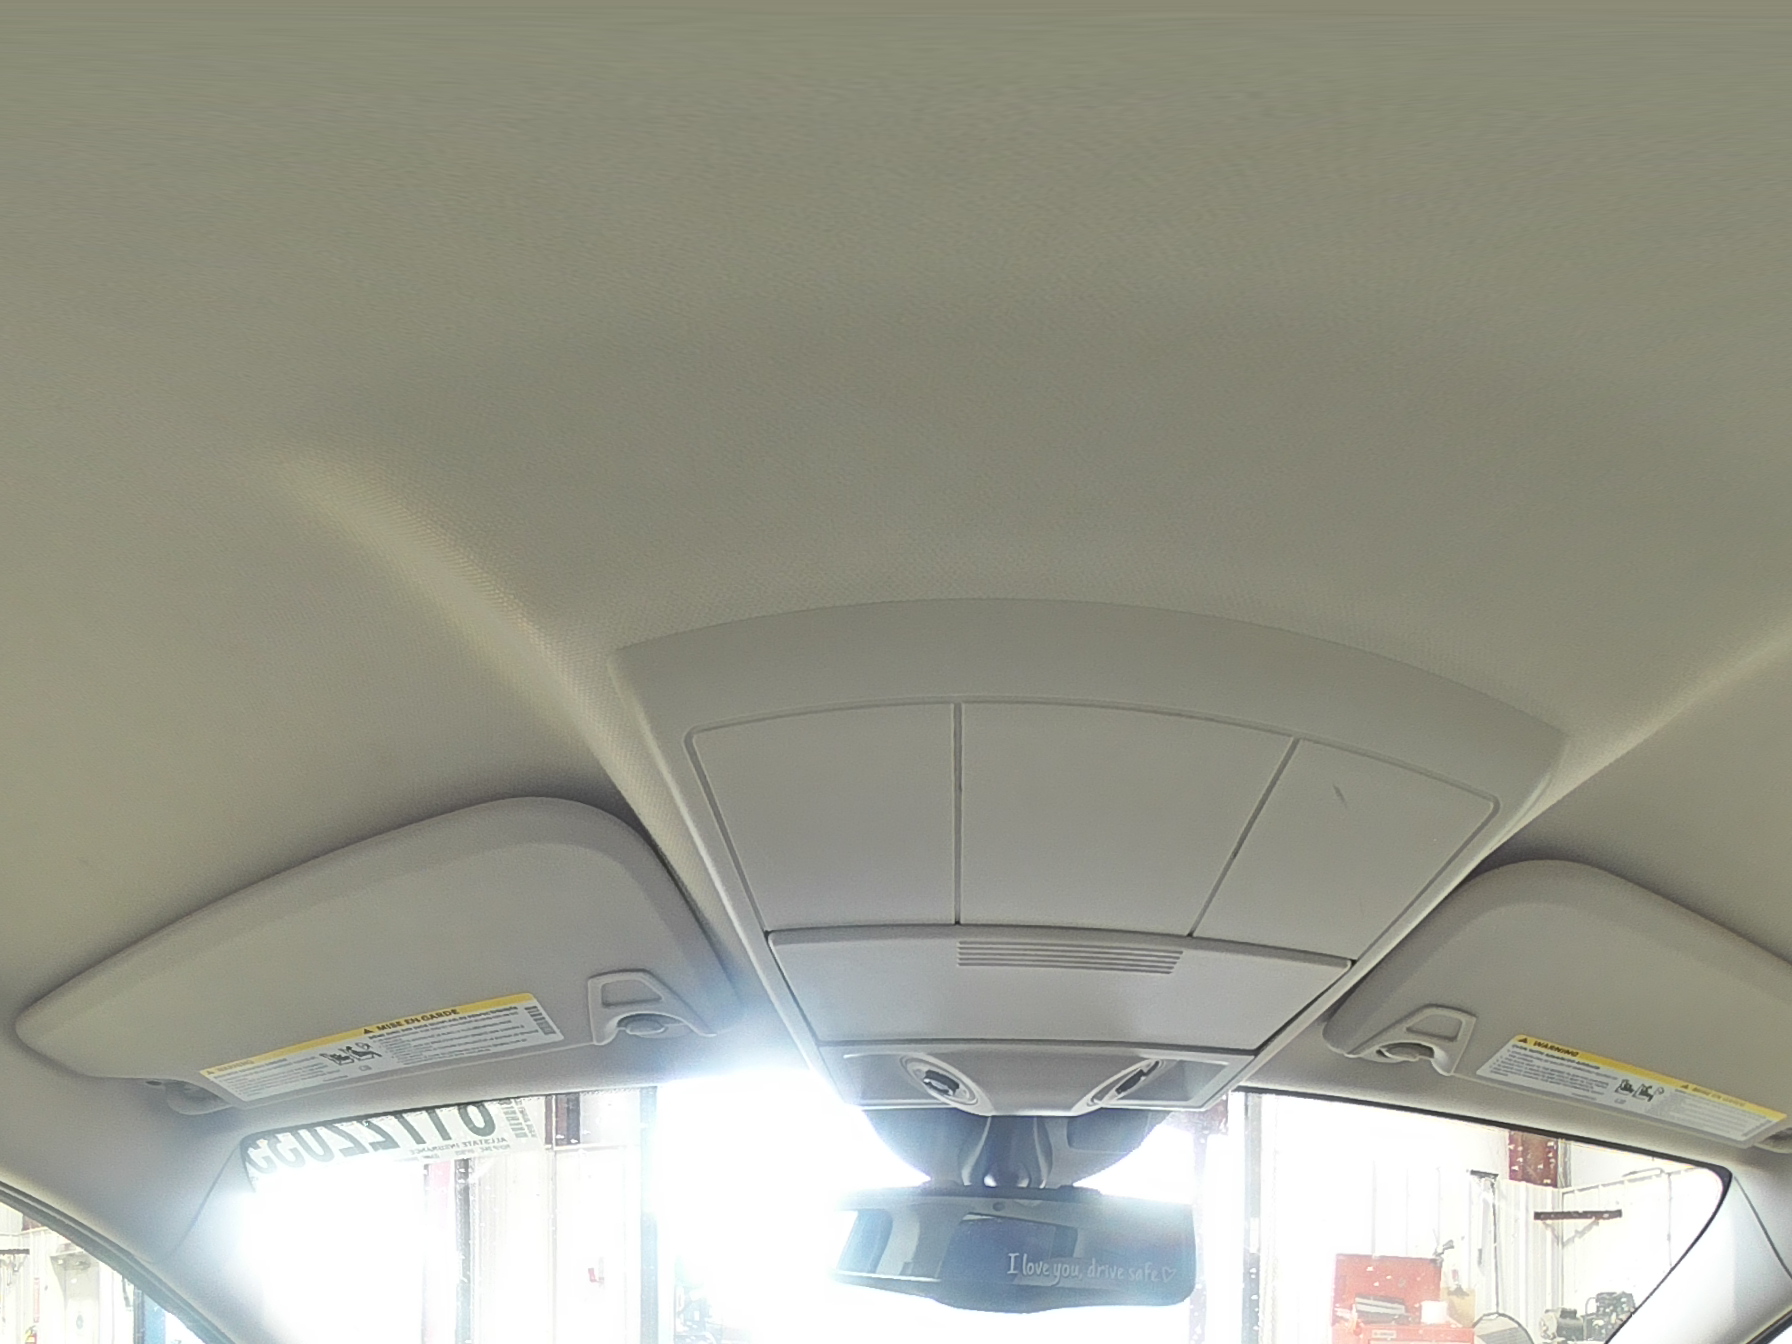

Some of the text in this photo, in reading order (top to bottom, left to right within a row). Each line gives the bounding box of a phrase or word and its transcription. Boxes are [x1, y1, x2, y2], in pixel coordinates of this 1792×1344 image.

[421, 1009, 460, 1022] GARDE
[1533, 1041, 1579, 1058] WARNING
[1007, 1252, 1159, 1282] I love you, drive safe
